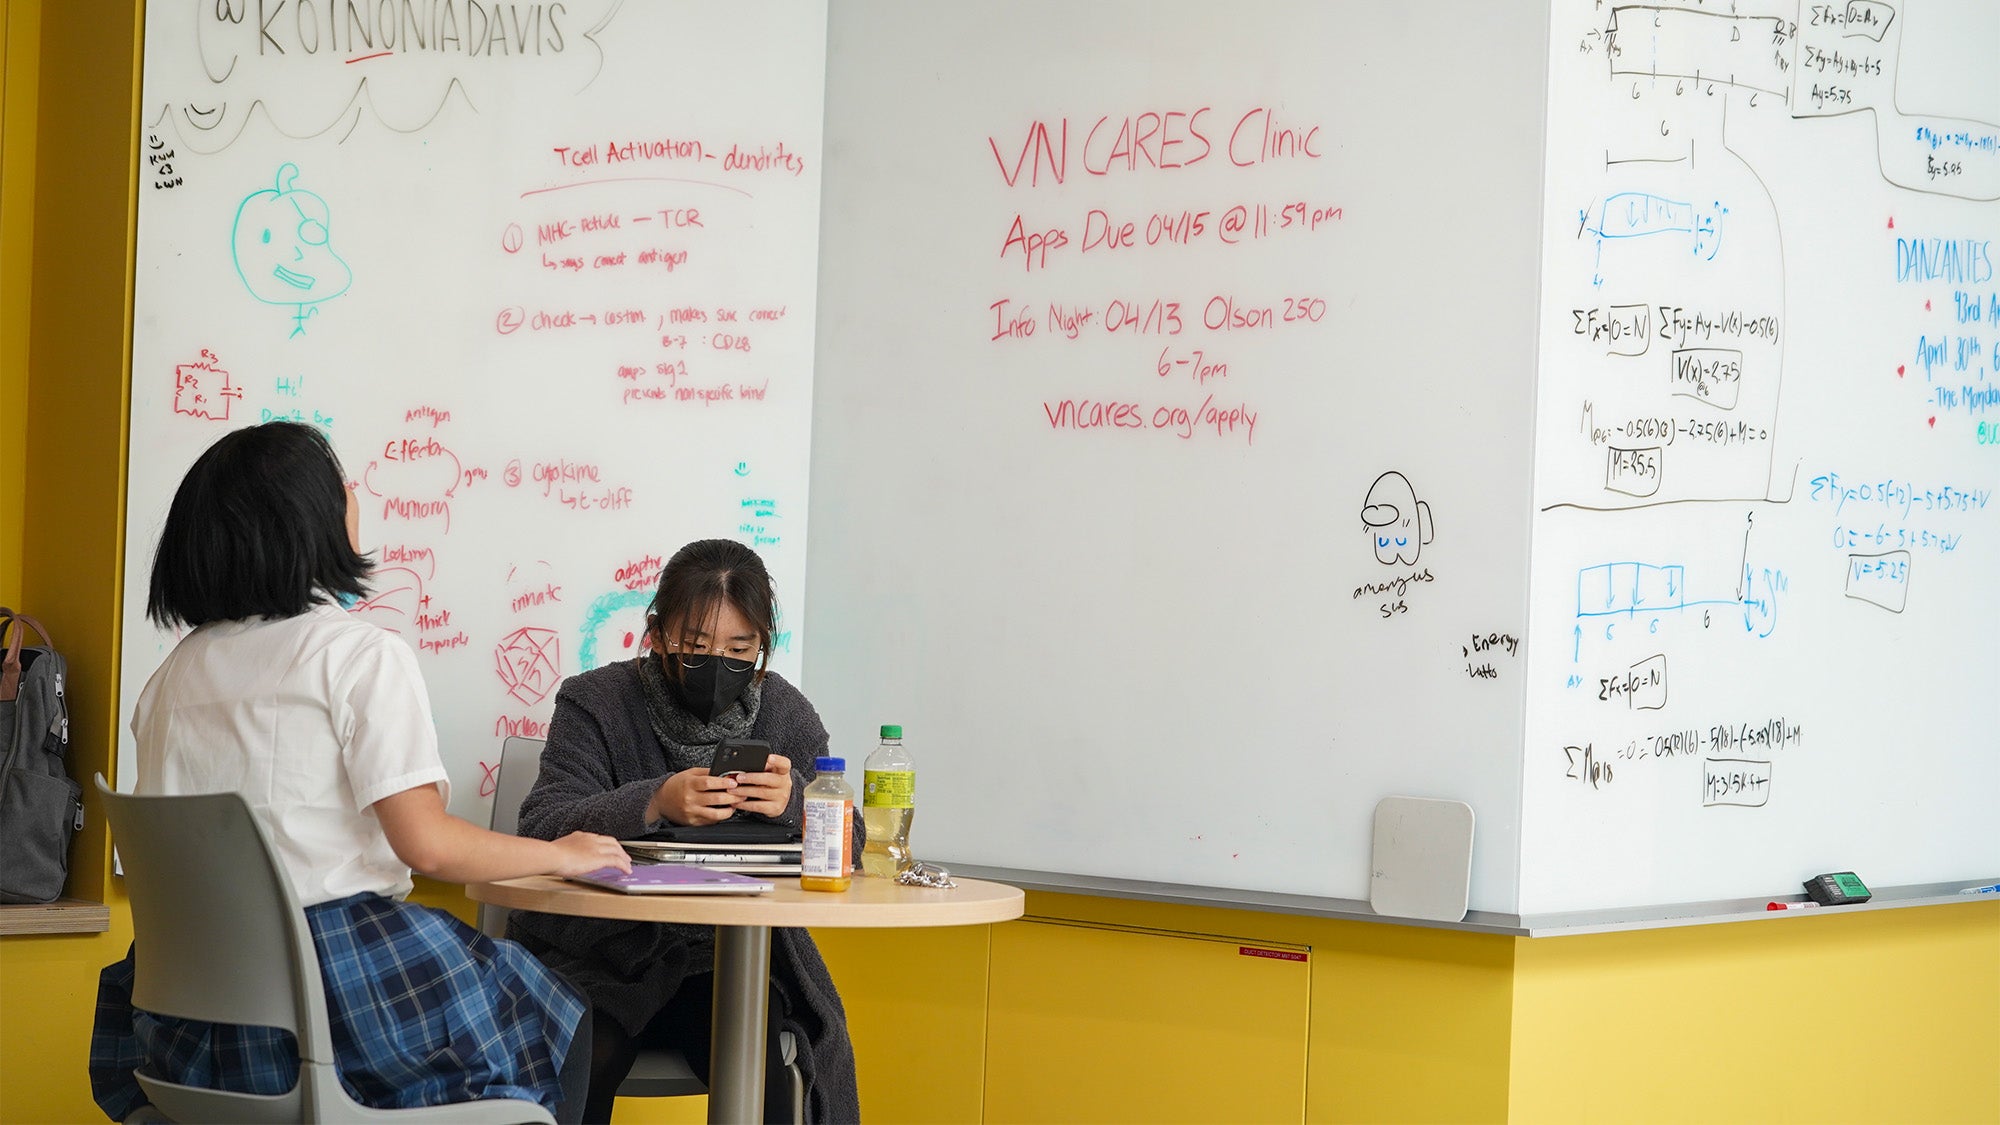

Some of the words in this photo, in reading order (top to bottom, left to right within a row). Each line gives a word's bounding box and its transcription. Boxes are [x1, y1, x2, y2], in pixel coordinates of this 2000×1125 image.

[723, 142, 805, 177] dendrites
[988, 117, 1068, 188] VN
[1082, 106, 1212, 176] CARES
[1228, 107, 1322, 168] Clinic
[658, 208, 705, 229] TCR
[1000, 211, 1070, 273] Apps
[1081, 209, 1135, 255] Due
[1146, 209, 1211, 247] 04/15
[1896, 237, 1993, 285] DANZANTES
[989, 298, 1037, 343] Info
[1104, 299, 1184, 336] 04/13
[1203, 295, 1273, 333] Olson
[1283, 296, 1327, 323] 250
[1954, 290, 1981, 325] 43rd
[1915, 335, 1948, 383] April
[276, 374, 304, 399] Hi!
[1043, 393, 1258, 448] vncares.org/apply
[1471, 632, 1520, 658] Energy
